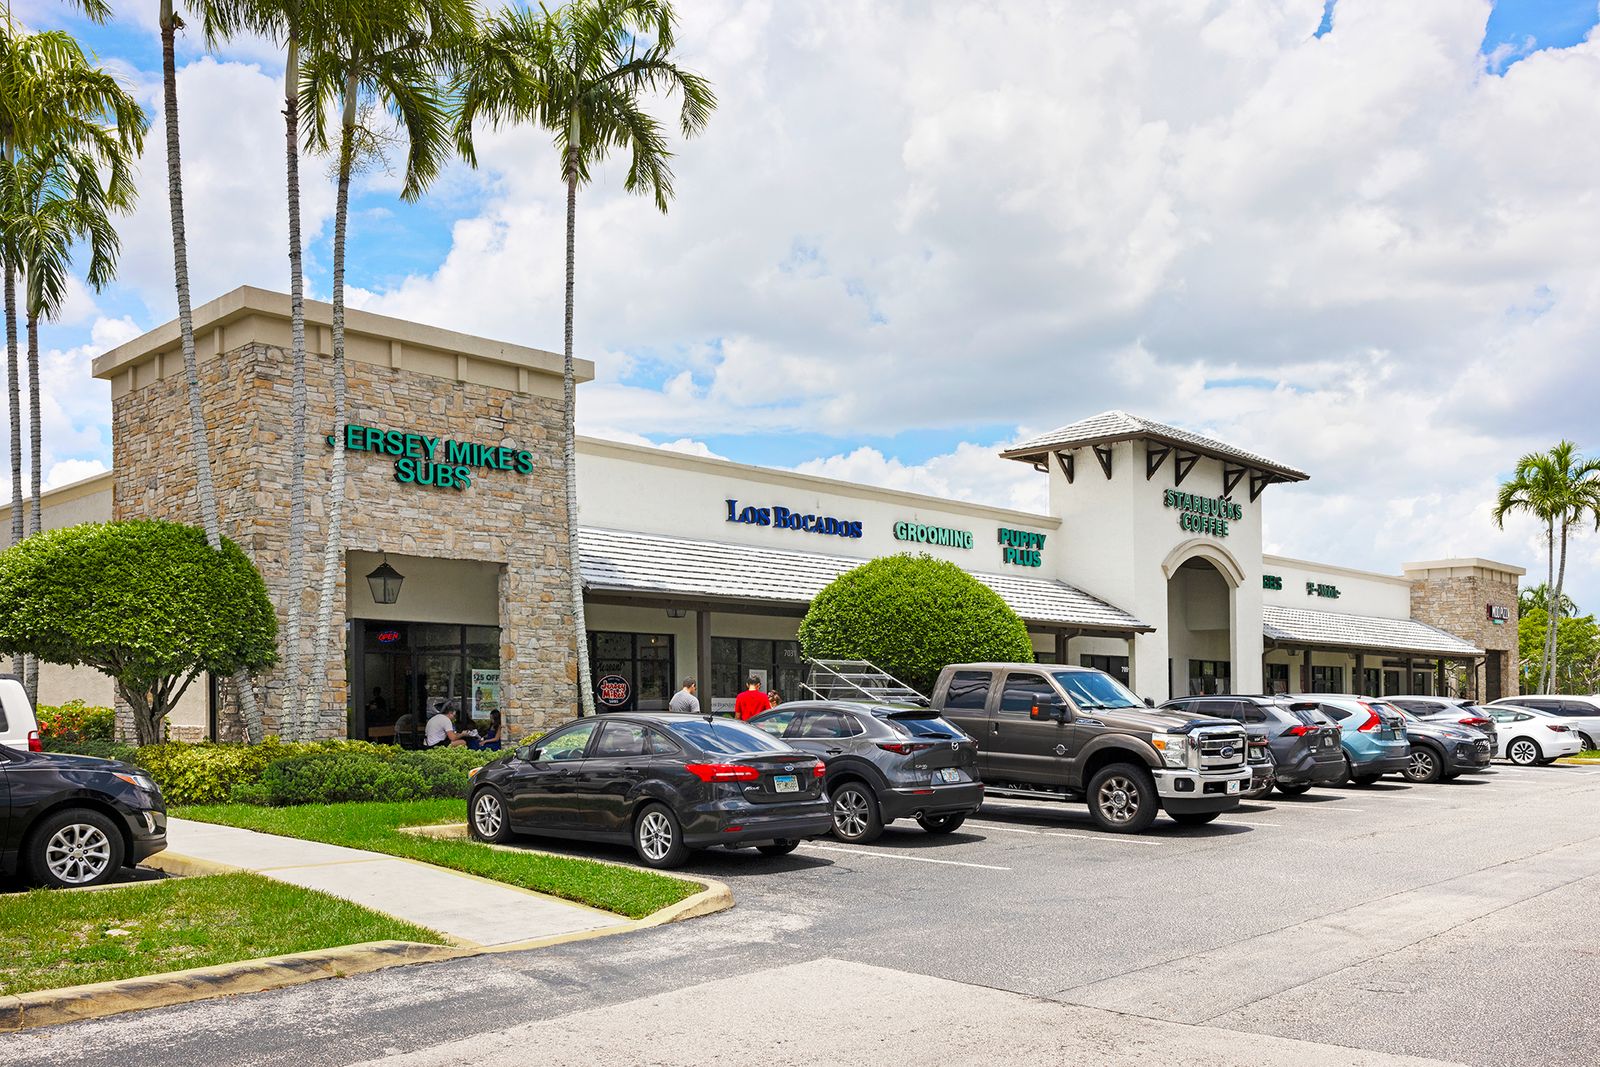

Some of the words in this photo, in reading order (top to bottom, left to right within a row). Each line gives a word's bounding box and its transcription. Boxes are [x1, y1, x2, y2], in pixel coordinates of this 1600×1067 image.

[445, 440, 533, 475] MIKE'S
[394, 458, 471, 489] SUBS
[1164, 488, 1243, 520] STARBUCKS
[893, 521, 974, 549] GROOMING
[1180, 512, 1229, 537] COFFEE
[998, 527, 1047, 551] PUPPY
[1003, 547, 1042, 567] PLUS
[600, 680, 626, 692] Jersey
